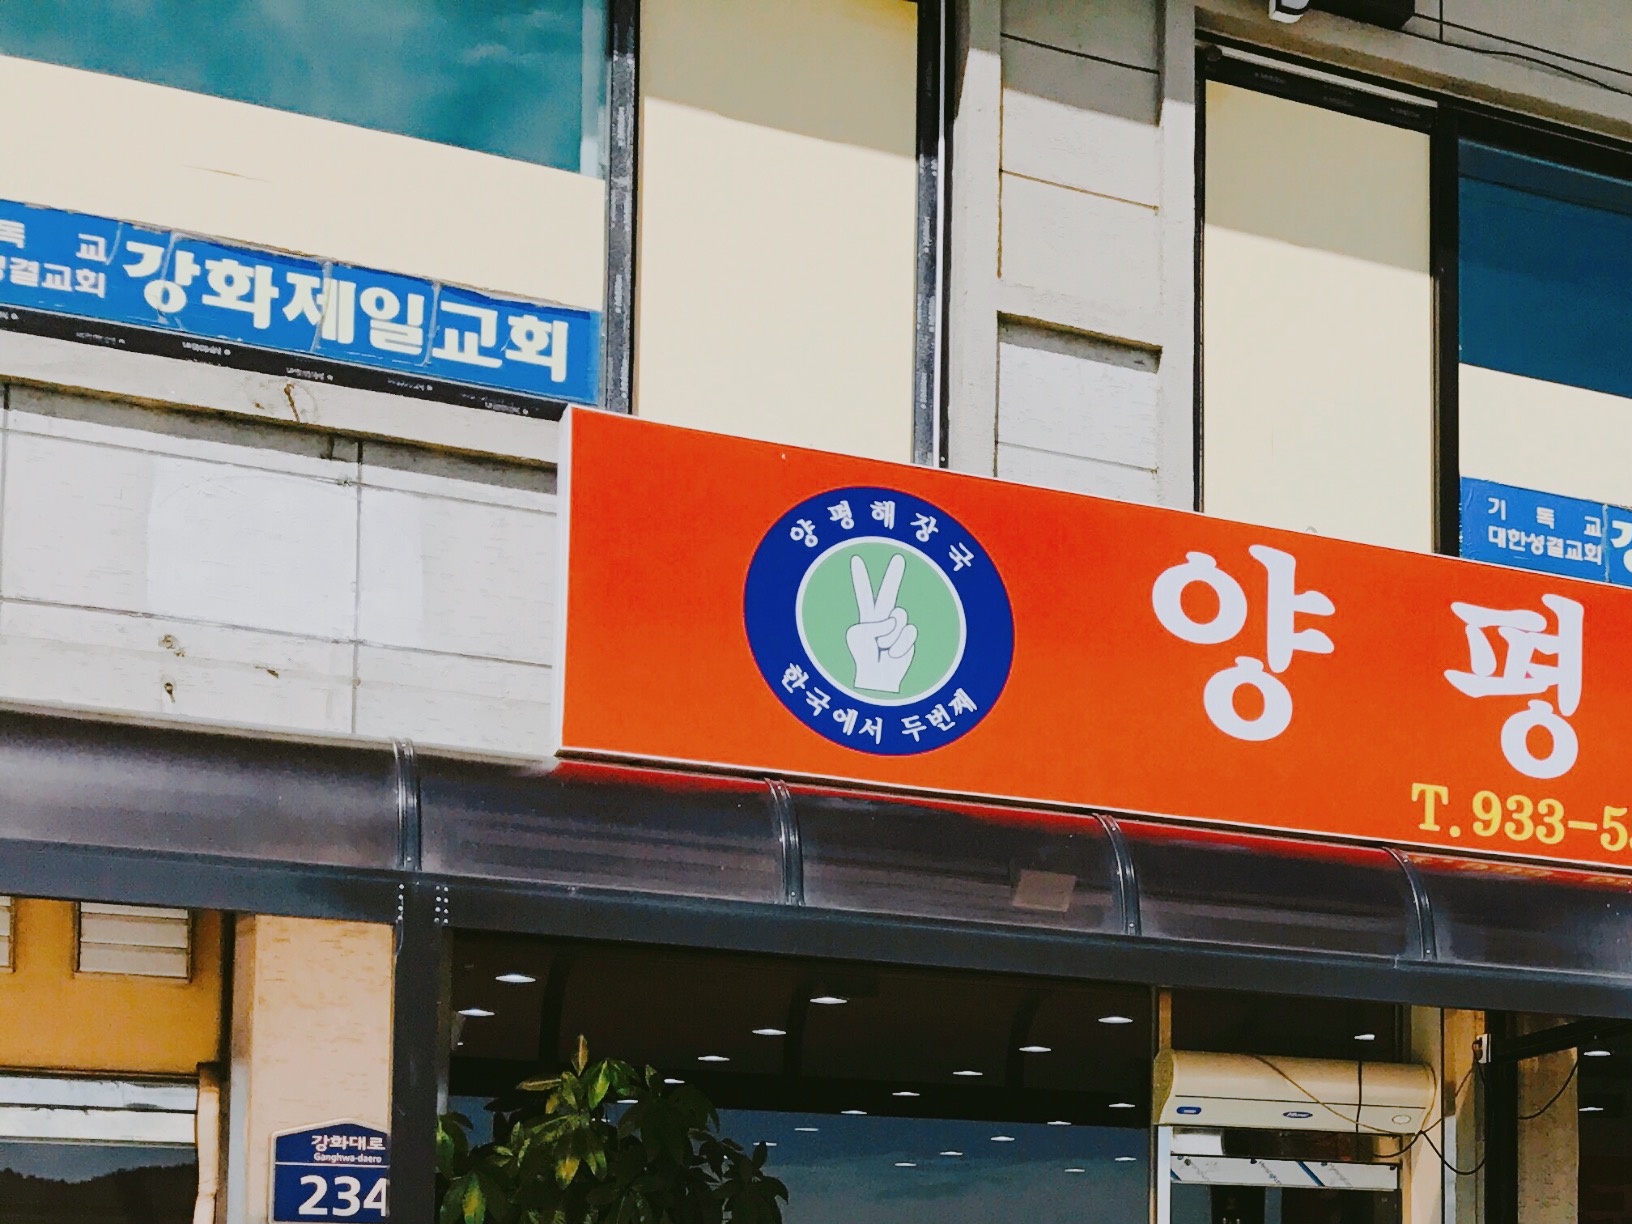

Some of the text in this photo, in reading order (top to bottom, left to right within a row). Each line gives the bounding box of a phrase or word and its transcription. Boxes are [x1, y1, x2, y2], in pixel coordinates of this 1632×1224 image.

[123, 240, 569, 383] 강화제일교회
[790, 500, 974, 572] 양평해장국
[1488, 526, 1602, 566] 대한성결교회
[781, 663, 978, 745] 한국에서 두번째
[311, 1135, 386, 1152] 강화대로
[313, 1152, 382, 1164] Ganghwa-daero
[298, 1174, 388, 1217] 234
